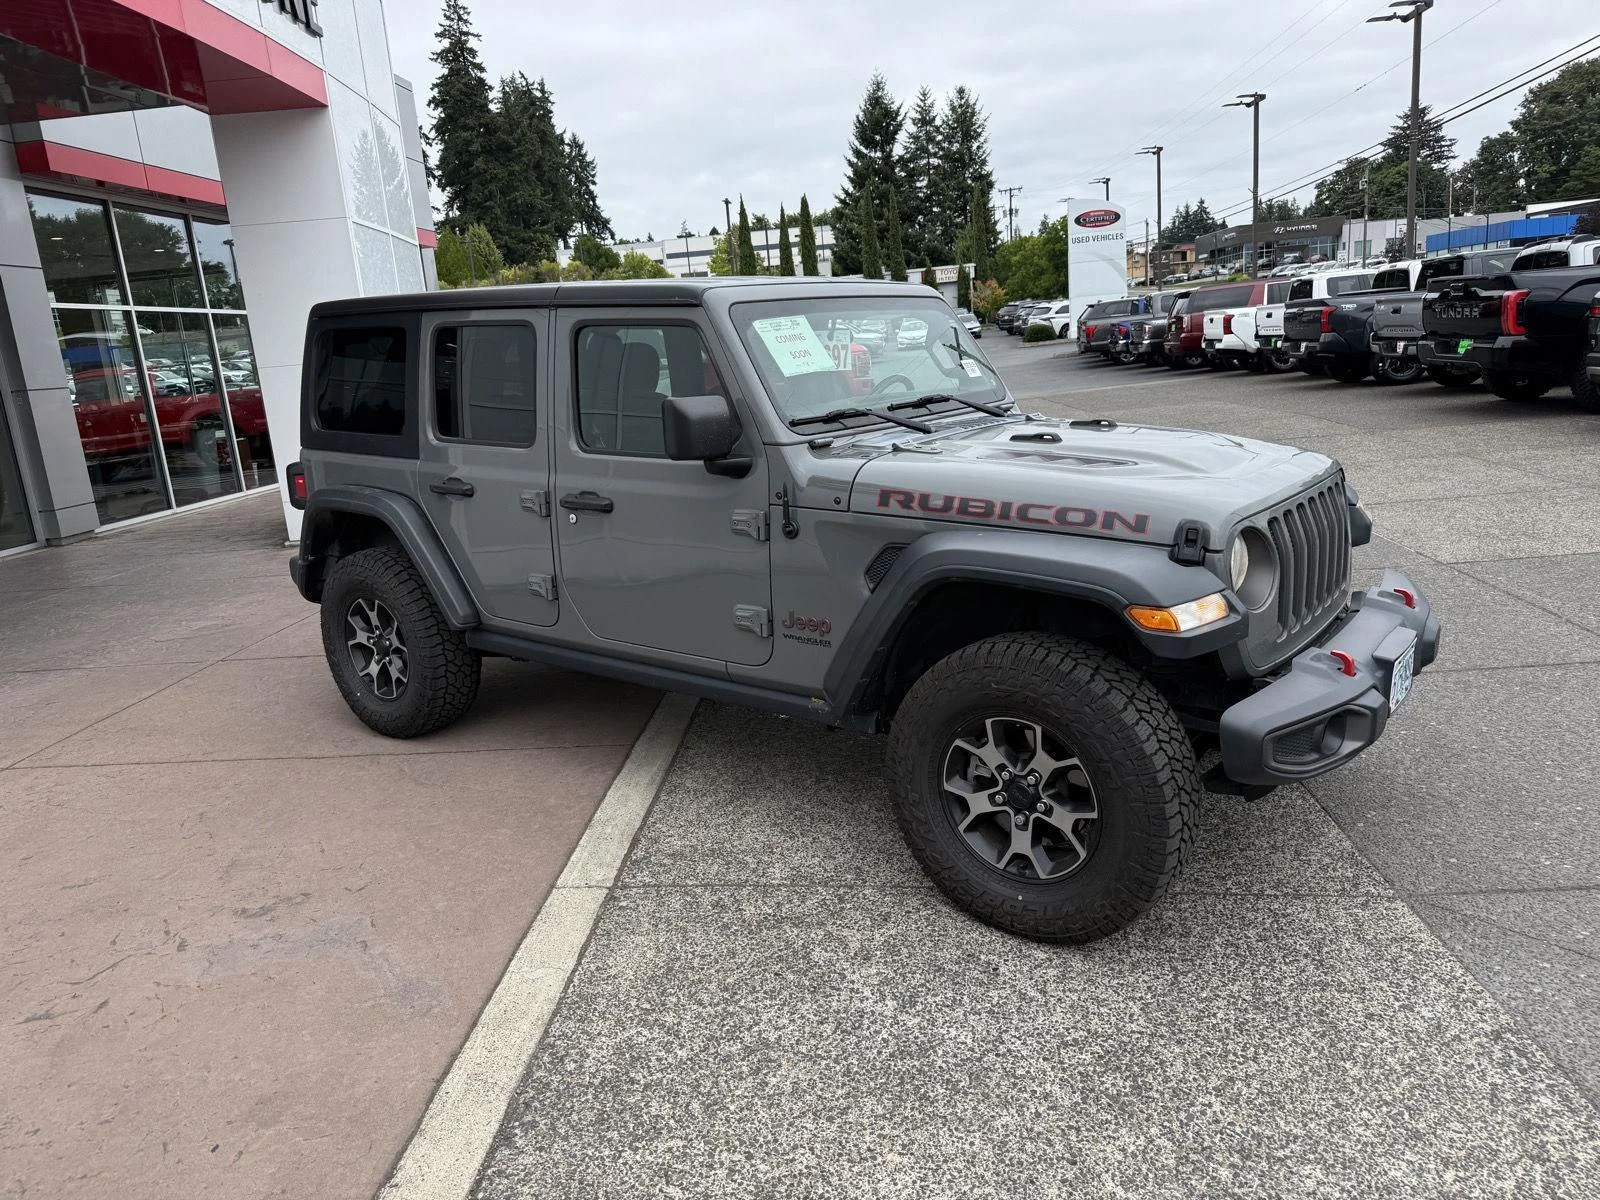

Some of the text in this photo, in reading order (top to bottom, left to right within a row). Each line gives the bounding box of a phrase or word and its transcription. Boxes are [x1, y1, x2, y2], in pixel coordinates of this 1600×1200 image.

[1080, 214, 1116, 223] CERTIFIED
[1071, 232, 1124, 244] USED VEHICLES
[1436, 307, 1480, 318] TUNDRA
[775, 332, 806, 344] COMING
[789, 348, 812, 360] SOON
[876, 488, 1150, 535] RUBICON
[782, 608, 832, 637] Jeep
[782, 633, 832, 646] WRANGLER
